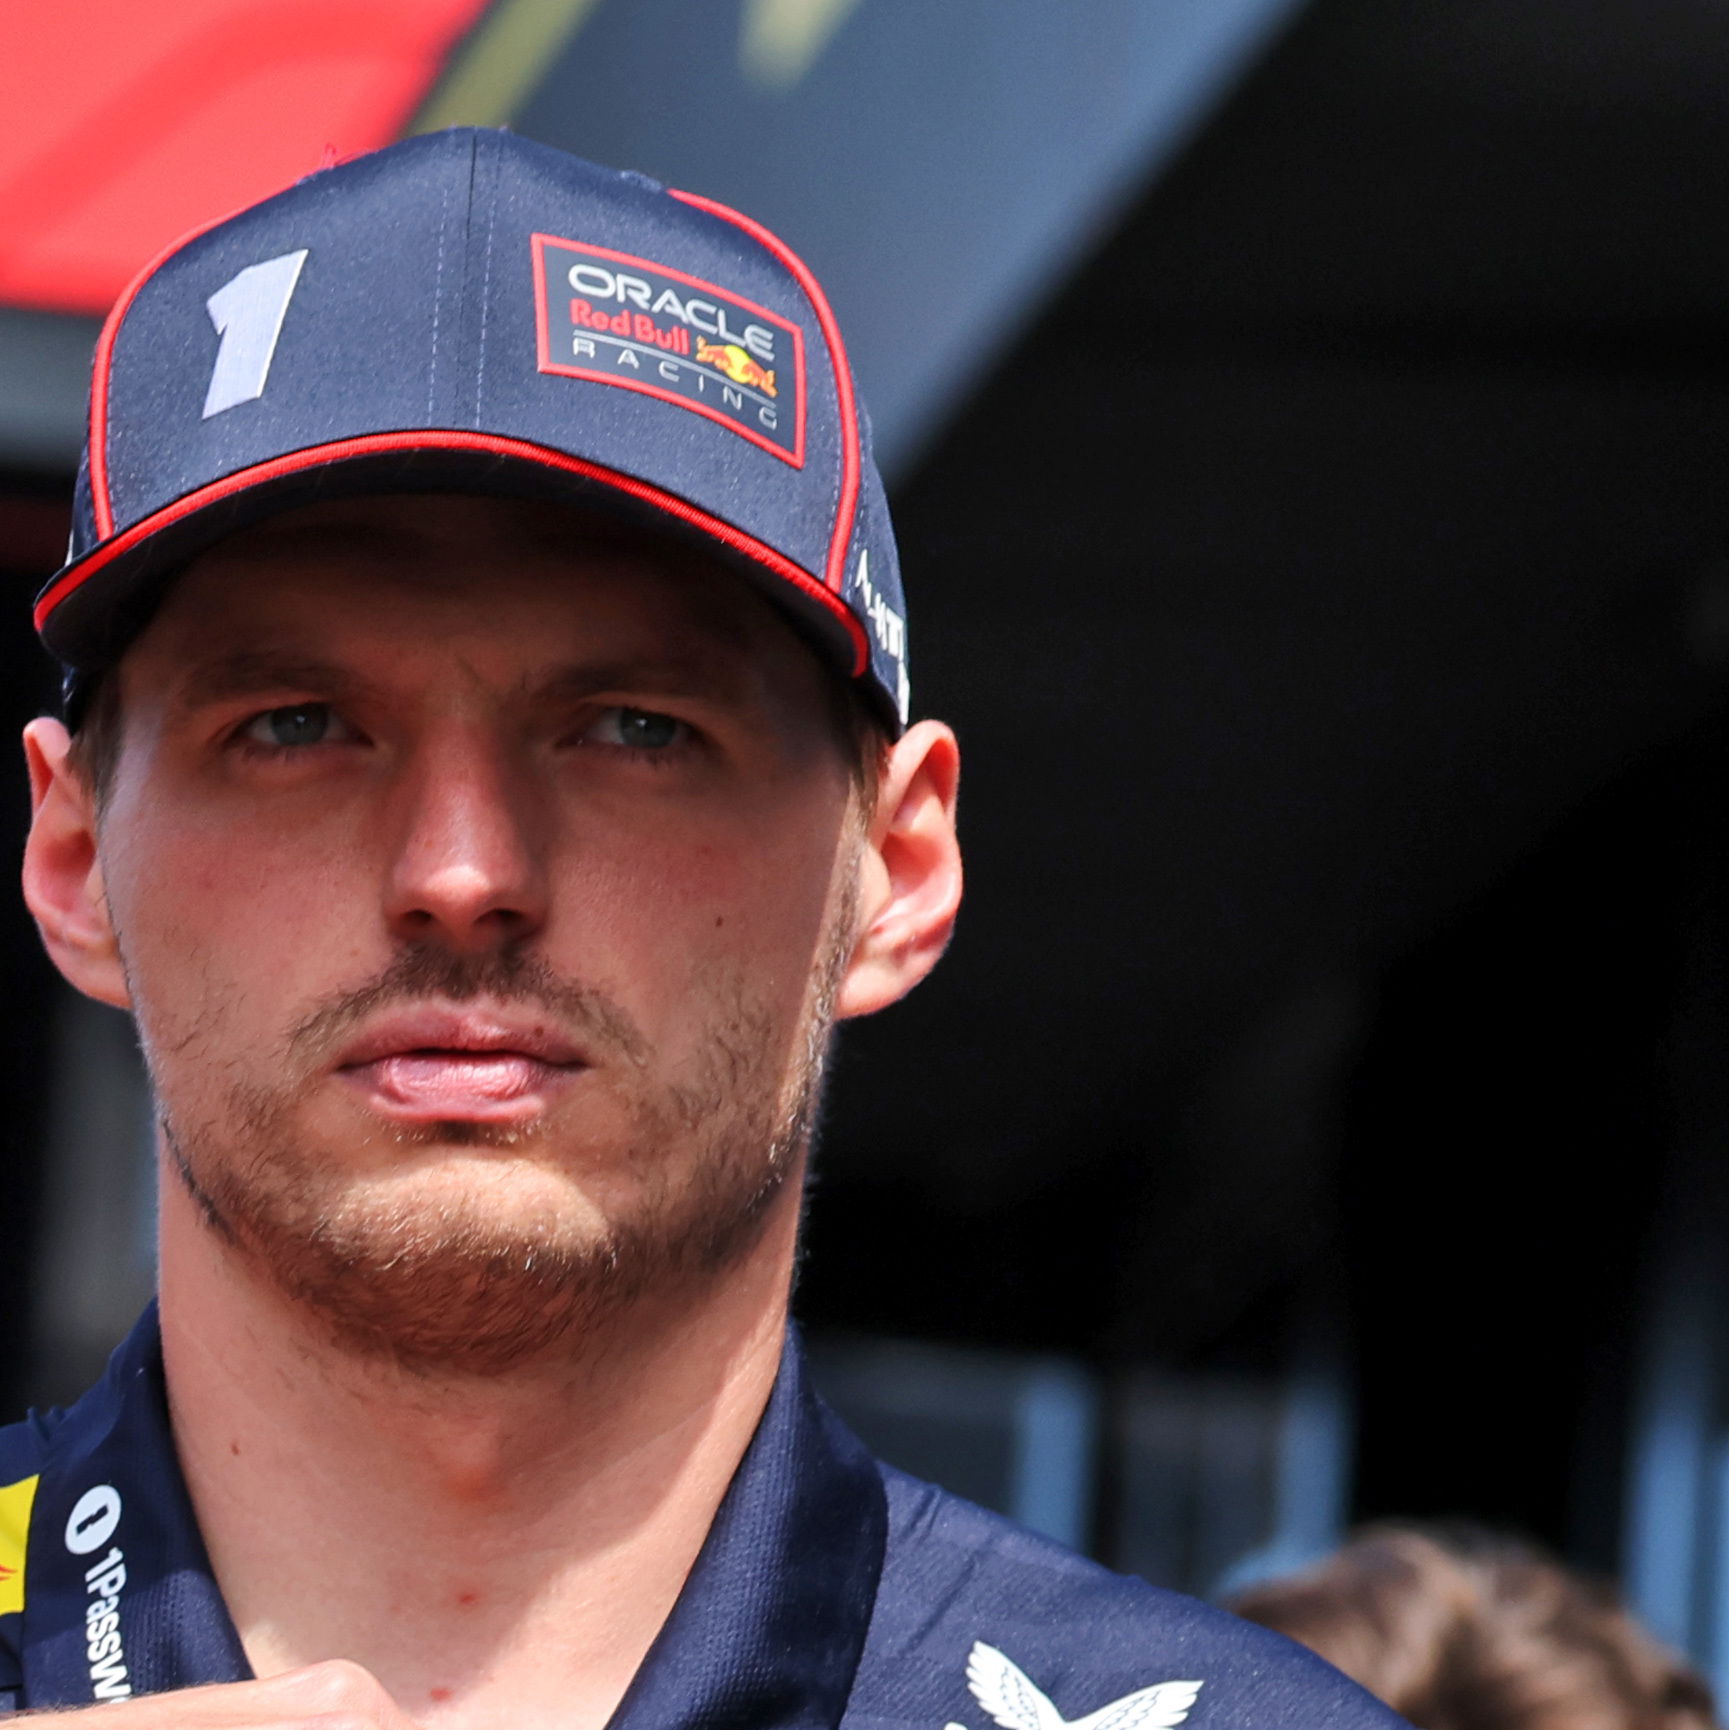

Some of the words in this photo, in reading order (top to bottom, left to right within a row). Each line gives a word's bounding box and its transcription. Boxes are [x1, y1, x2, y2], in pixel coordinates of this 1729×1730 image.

[202, 248, 309, 421] 1
[568, 263, 775, 362] ORACLE
[569, 298, 632, 337] Red
[633, 313, 691, 356] Bull
[572, 337, 778, 430] RACING
[84, 1546, 132, 1704] 1Passw
